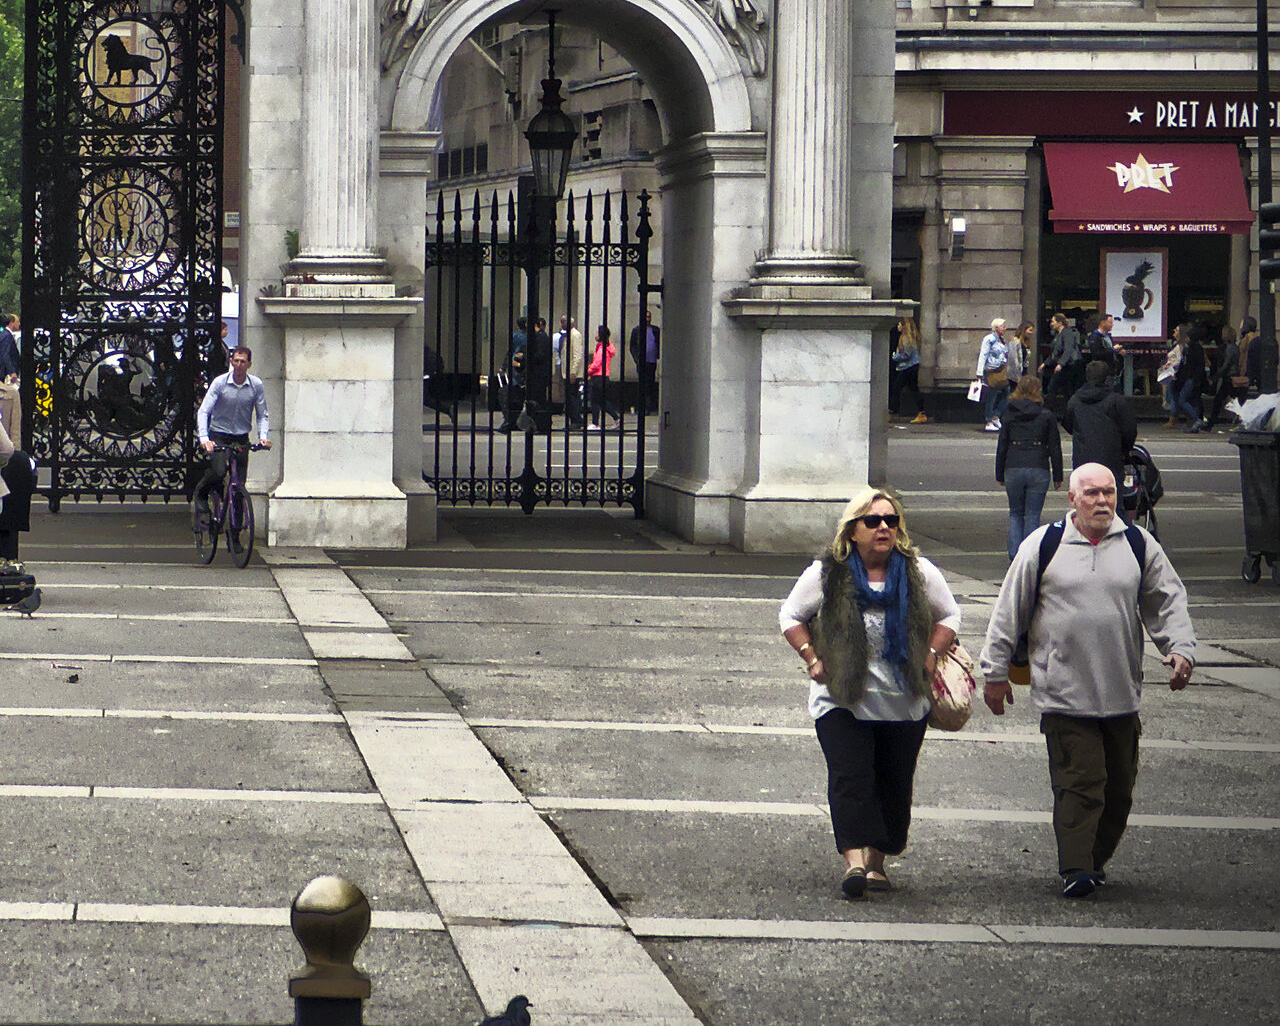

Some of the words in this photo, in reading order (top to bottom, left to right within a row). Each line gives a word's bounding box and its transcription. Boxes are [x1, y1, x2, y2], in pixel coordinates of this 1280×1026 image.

[1156, 101, 1200, 128] PRET
[1205, 101, 1217, 128] A
[1225, 101, 1280, 128] MAN
[1115, 161, 1174, 188] PRET
[1087, 224, 1131, 232] SANDWICHES
[1143, 224, 1167, 232] WRAPS
[1179, 224, 1217, 232] BAGUETTES
